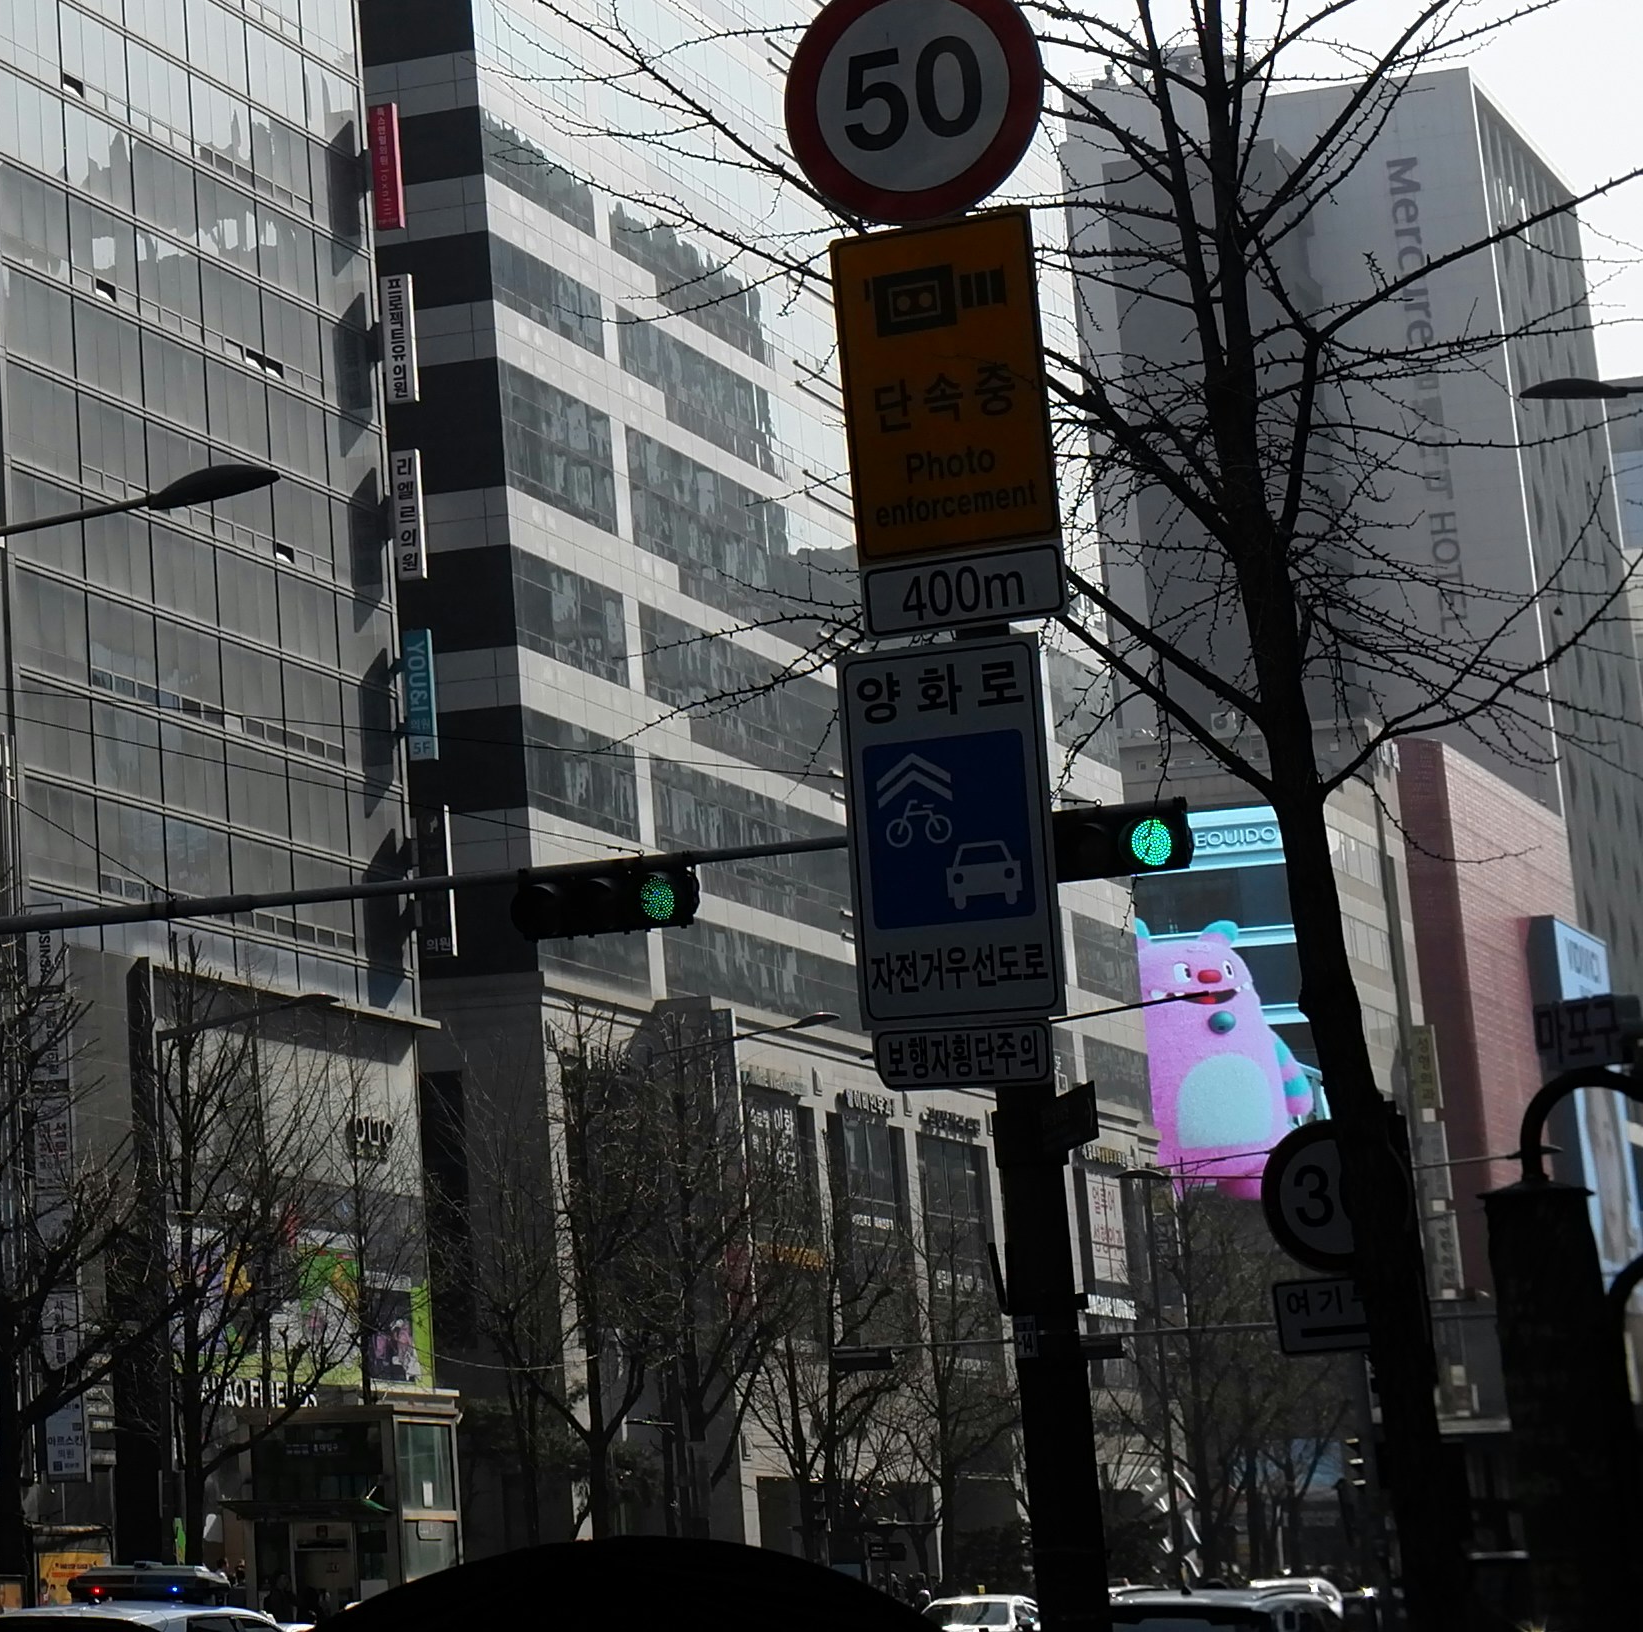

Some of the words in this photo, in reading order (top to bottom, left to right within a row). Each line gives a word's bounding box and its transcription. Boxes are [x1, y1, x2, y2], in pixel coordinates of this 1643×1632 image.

[844, 35, 983, 152] 50
[1384, 156, 1435, 347] Mercure
[874, 362, 1016, 433] 단속중
[905, 445, 996, 483] Photo
[875, 480, 1037, 528] enforcement
[902, 566, 1025, 622] 400m
[407, 640, 428, 713] YOU&I
[857, 661, 1024, 724] 양화로
[413, 741, 431, 755] 5F
[426, 936, 451, 952] 의원
[871, 943, 1049, 995] 자전거우선도로
[887, 1030, 1041, 1079] 보행자횡단주의
[1533, 1004, 1619, 1058] 마포구
[1294, 1164, 1334, 1228] 3
[1286, 1284, 1363, 1316] 여기
